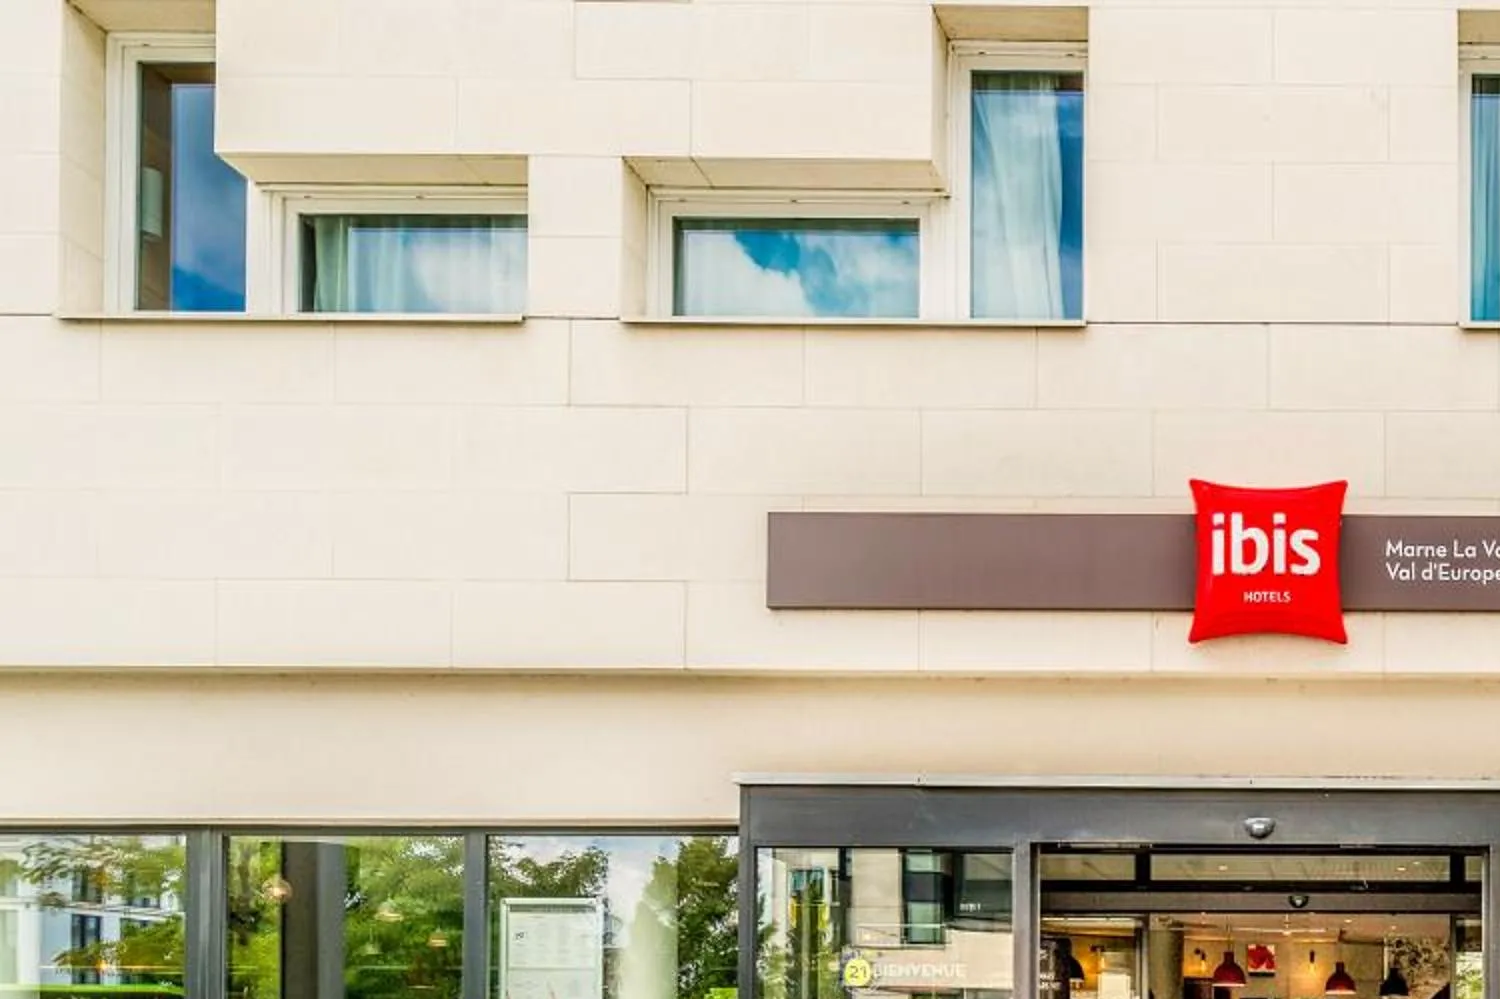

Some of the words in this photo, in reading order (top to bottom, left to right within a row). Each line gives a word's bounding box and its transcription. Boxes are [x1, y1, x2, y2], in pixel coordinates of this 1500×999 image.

[1211, 512, 1321, 576] ibis
[1386, 540, 1447, 559] Marne
[1453, 540, 1476, 559] La
[1385, 563, 1416, 582] Val
[1243, 591, 1291, 603] HOTELS
